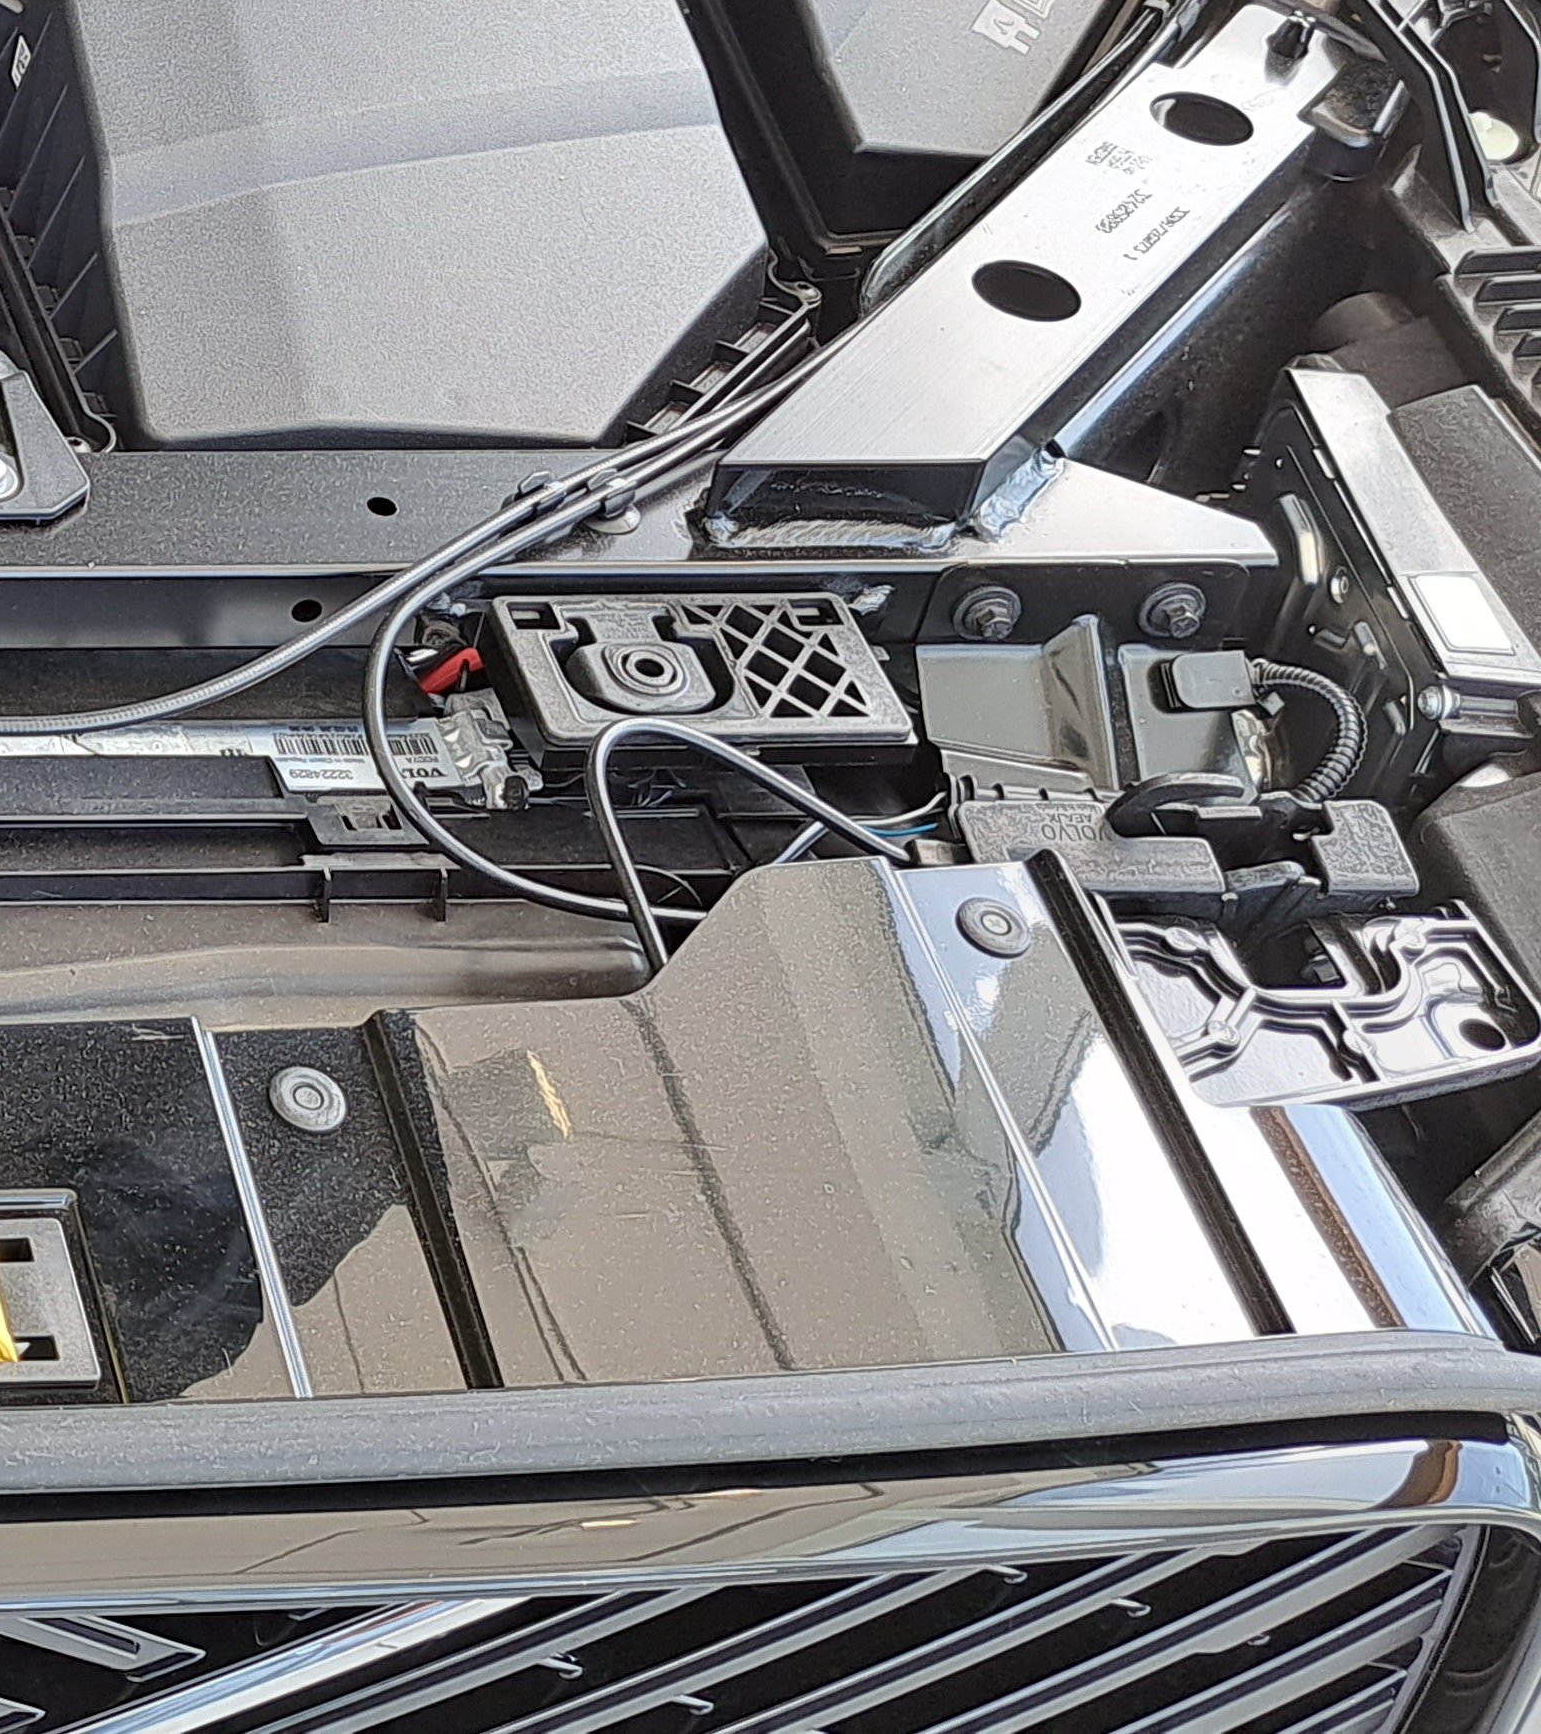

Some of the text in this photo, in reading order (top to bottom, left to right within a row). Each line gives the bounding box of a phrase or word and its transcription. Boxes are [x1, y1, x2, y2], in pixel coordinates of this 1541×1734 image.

[289, 769, 354, 780] 32224829
[402, 767, 447, 778] VOL
[1040, 823, 1114, 843] VOLVO
